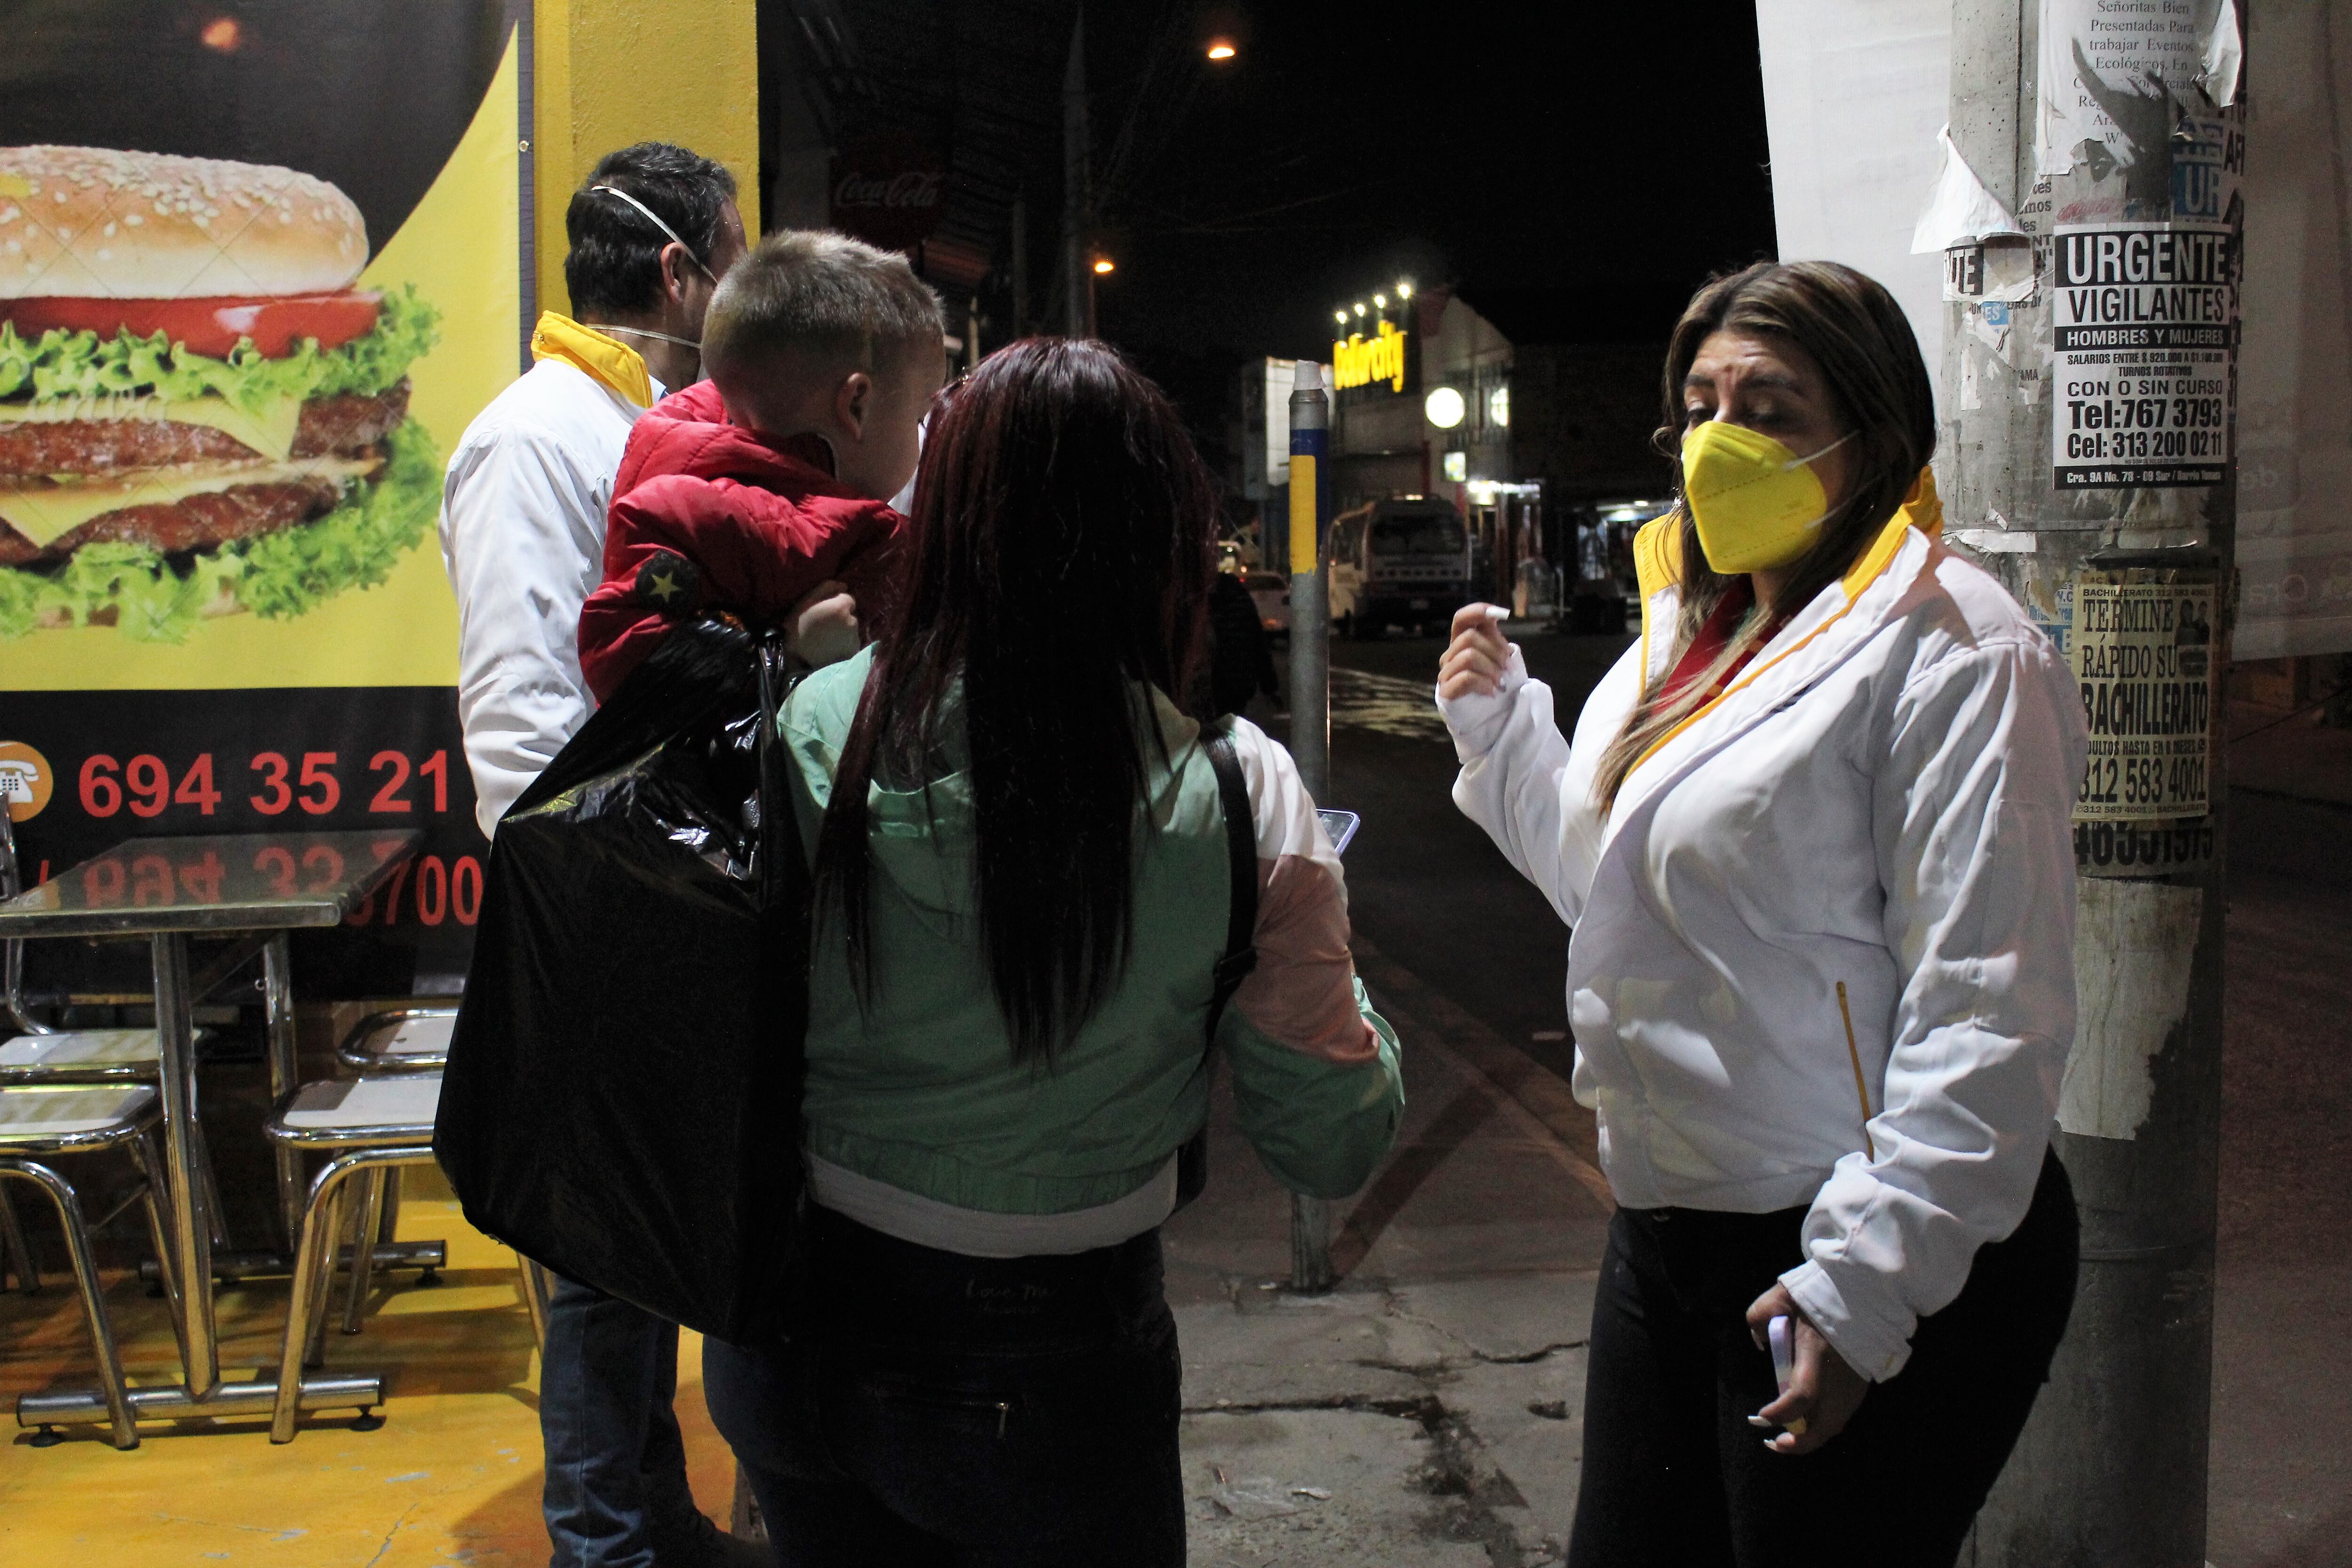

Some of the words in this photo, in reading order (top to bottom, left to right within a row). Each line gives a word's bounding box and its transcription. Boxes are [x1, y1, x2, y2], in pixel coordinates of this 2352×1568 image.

[2098, 0, 2156, 13] Señoritas
[2163, 2, 2189, 14] Bien
[2090, 19, 2164, 32] Presentadas
[2169, 21, 2194, 33] Para
[2090, 38, 2139, 54] trabajar
[2147, 39, 2193, 52] Eventos
[2067, 233, 2226, 284] URGENTE
[2068, 287, 2224, 323] VIGILANTES
[2067, 329, 2149, 347] HOMBRES
[2154, 329, 2165, 344] Y
[2169, 329, 2224, 345] MUJERES
[2067, 353, 2110, 365] SALARIOS
[2114, 352, 2139, 364] ENTRE
[2118, 366, 2151, 377] TURNOS
[2067, 381, 2109, 397] CON
[2118, 380, 2130, 396] O
[2138, 380, 2169, 395] SIN
[2176, 380, 2222, 395] CURSO
[2172, 398, 2222, 428] 3793
[2067, 432, 2107, 459] Cel:
[2112, 431, 2148, 458] 313
[2152, 430, 2186, 457] 200
[2067, 472, 2087, 483] Cra.
[2105, 471, 2119, 483] No.
[2083, 588, 2153, 597] BACHILLERATO
[2083, 598, 2174, 632] TERMINE
[2081, 634, 2151, 678] RÁPIDO
[2157, 644, 2177, 678] SU
[2081, 682, 2209, 736] BACHILLERATO
[2123, 740, 2150, 756] HASTA
[2153, 740, 2163, 756] EN
[78, 753, 222, 818] 694
[249, 752, 341, 815] 35
[368, 749, 448, 813] 21
[2078, 757, 2118, 803] 312
[2125, 757, 2163, 803] 583
[2168, 756, 2207, 802] 4001
[2104, 805, 2122, 814] 583
[2156, 803, 2206, 813] BACHILLERATO
